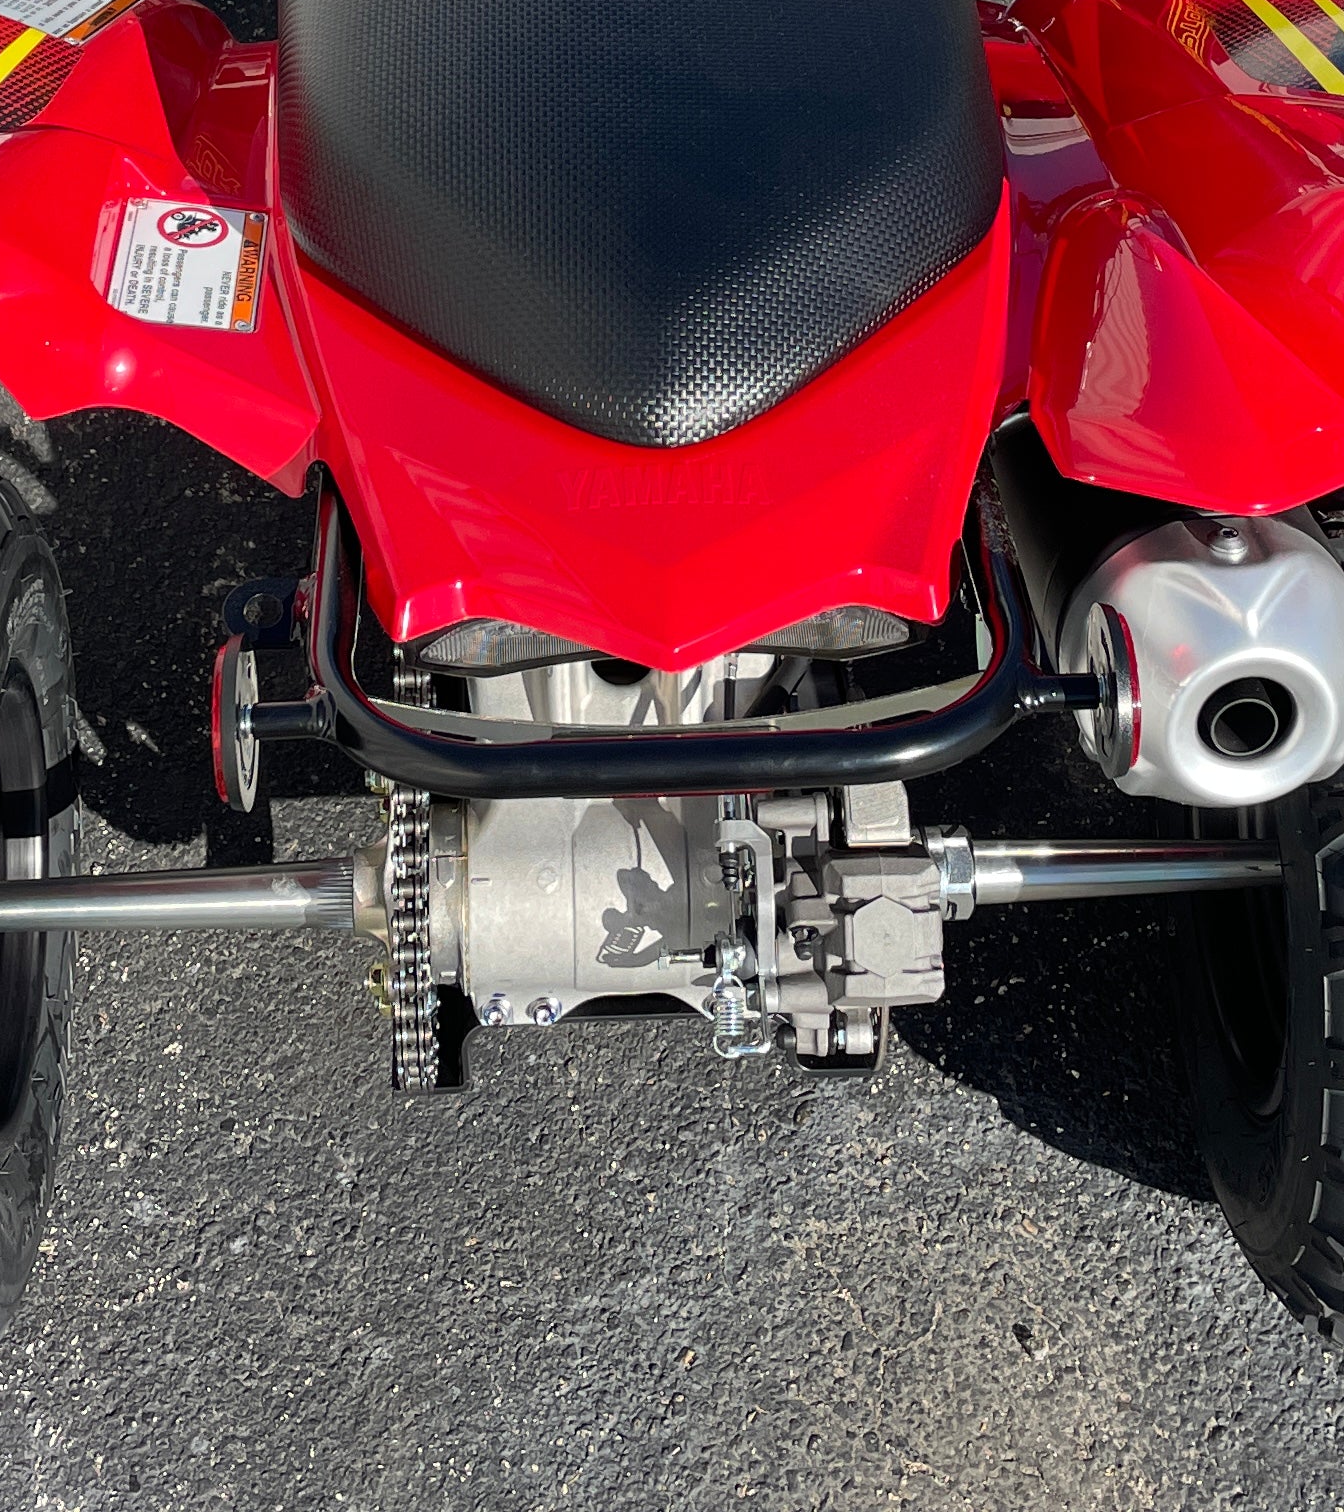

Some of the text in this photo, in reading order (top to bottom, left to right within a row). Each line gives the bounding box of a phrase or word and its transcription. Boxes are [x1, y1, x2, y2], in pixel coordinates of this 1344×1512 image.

[159, 268, 169, 276] of
[161, 252, 172, 267] loss
[170, 248, 188, 288] Passengers
[124, 244, 145, 306] INJURY or DEATH.
[137, 245, 159, 315] resulting in SEVERE
[219, 271, 232, 295] NEVER
[237, 247, 258, 303] WARNING
[153, 276, 168, 303] control,
[170, 289, 180, 302] can
[217, 296, 228, 310] ride
[198, 286, 213, 324] passenger.
[216, 311, 225, 320] as
[556, 464, 776, 511] YAMAHA
